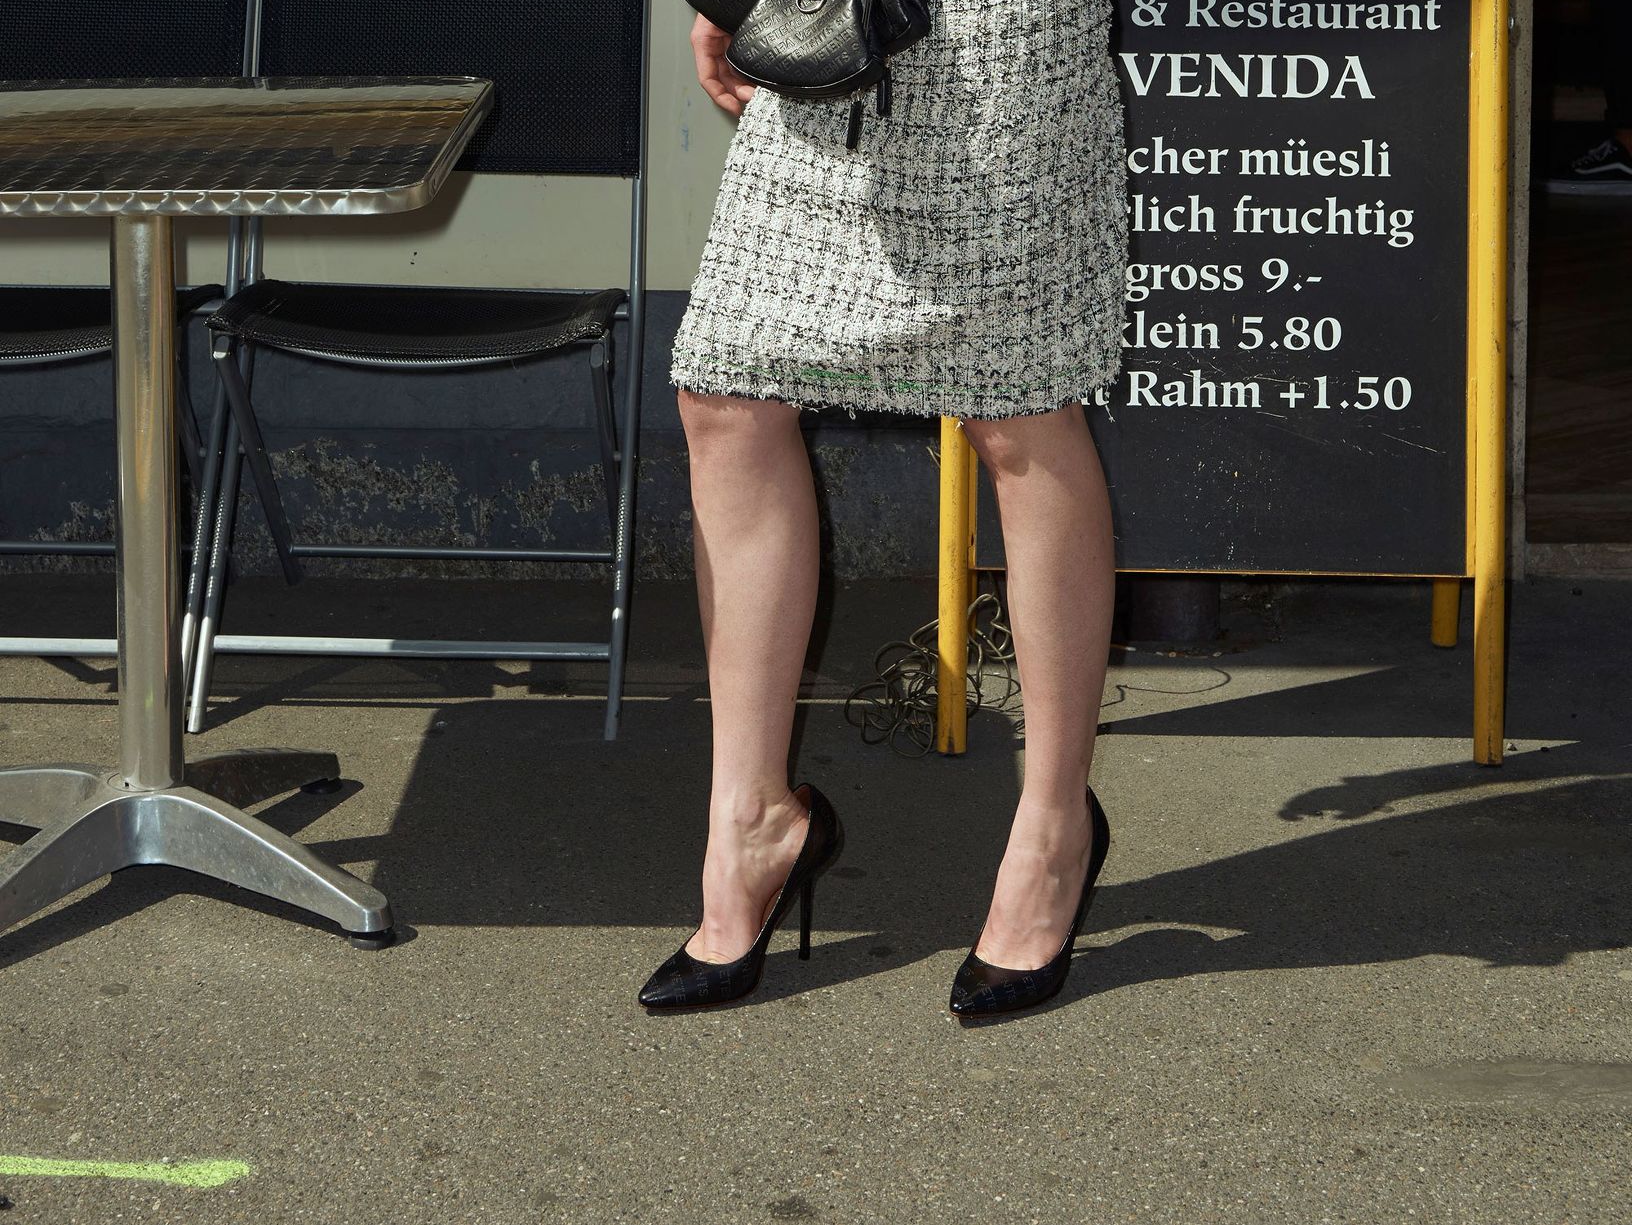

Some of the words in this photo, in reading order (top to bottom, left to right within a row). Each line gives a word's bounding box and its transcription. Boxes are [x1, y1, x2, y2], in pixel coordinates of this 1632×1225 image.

[1119, 53, 1375, 99] VENIDA
[1128, 136, 1228, 174] cher
[1239, 139, 1391, 176] müesli
[1127, 194, 1216, 232] lich
[1233, 195, 1414, 247] fruchtig
[1124, 264, 1243, 302] gross
[1262, 258, 1322, 292] 9.-
[1238, 317, 1341, 350] 5.80
[1127, 370, 1261, 407] Rahm
[1280, 376, 1411, 410] +1.50
